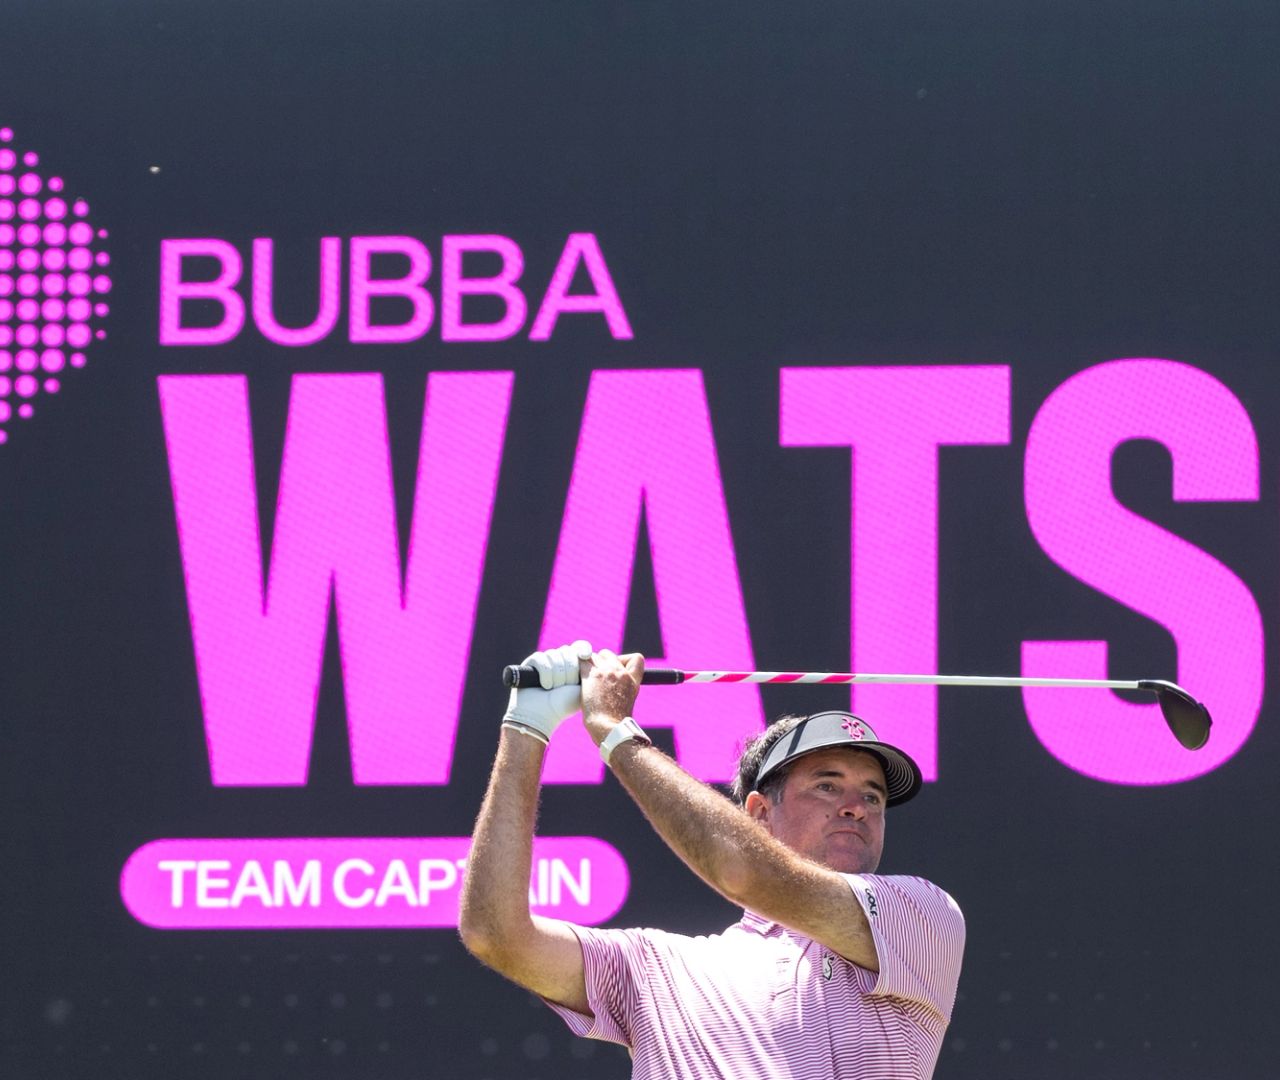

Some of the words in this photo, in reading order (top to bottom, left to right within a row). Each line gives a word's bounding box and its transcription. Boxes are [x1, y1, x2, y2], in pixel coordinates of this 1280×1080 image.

[158, 232, 635, 348] BUBBA
[158, 859, 321, 908] TEAM
[332, 857, 592, 907] CAPIN
